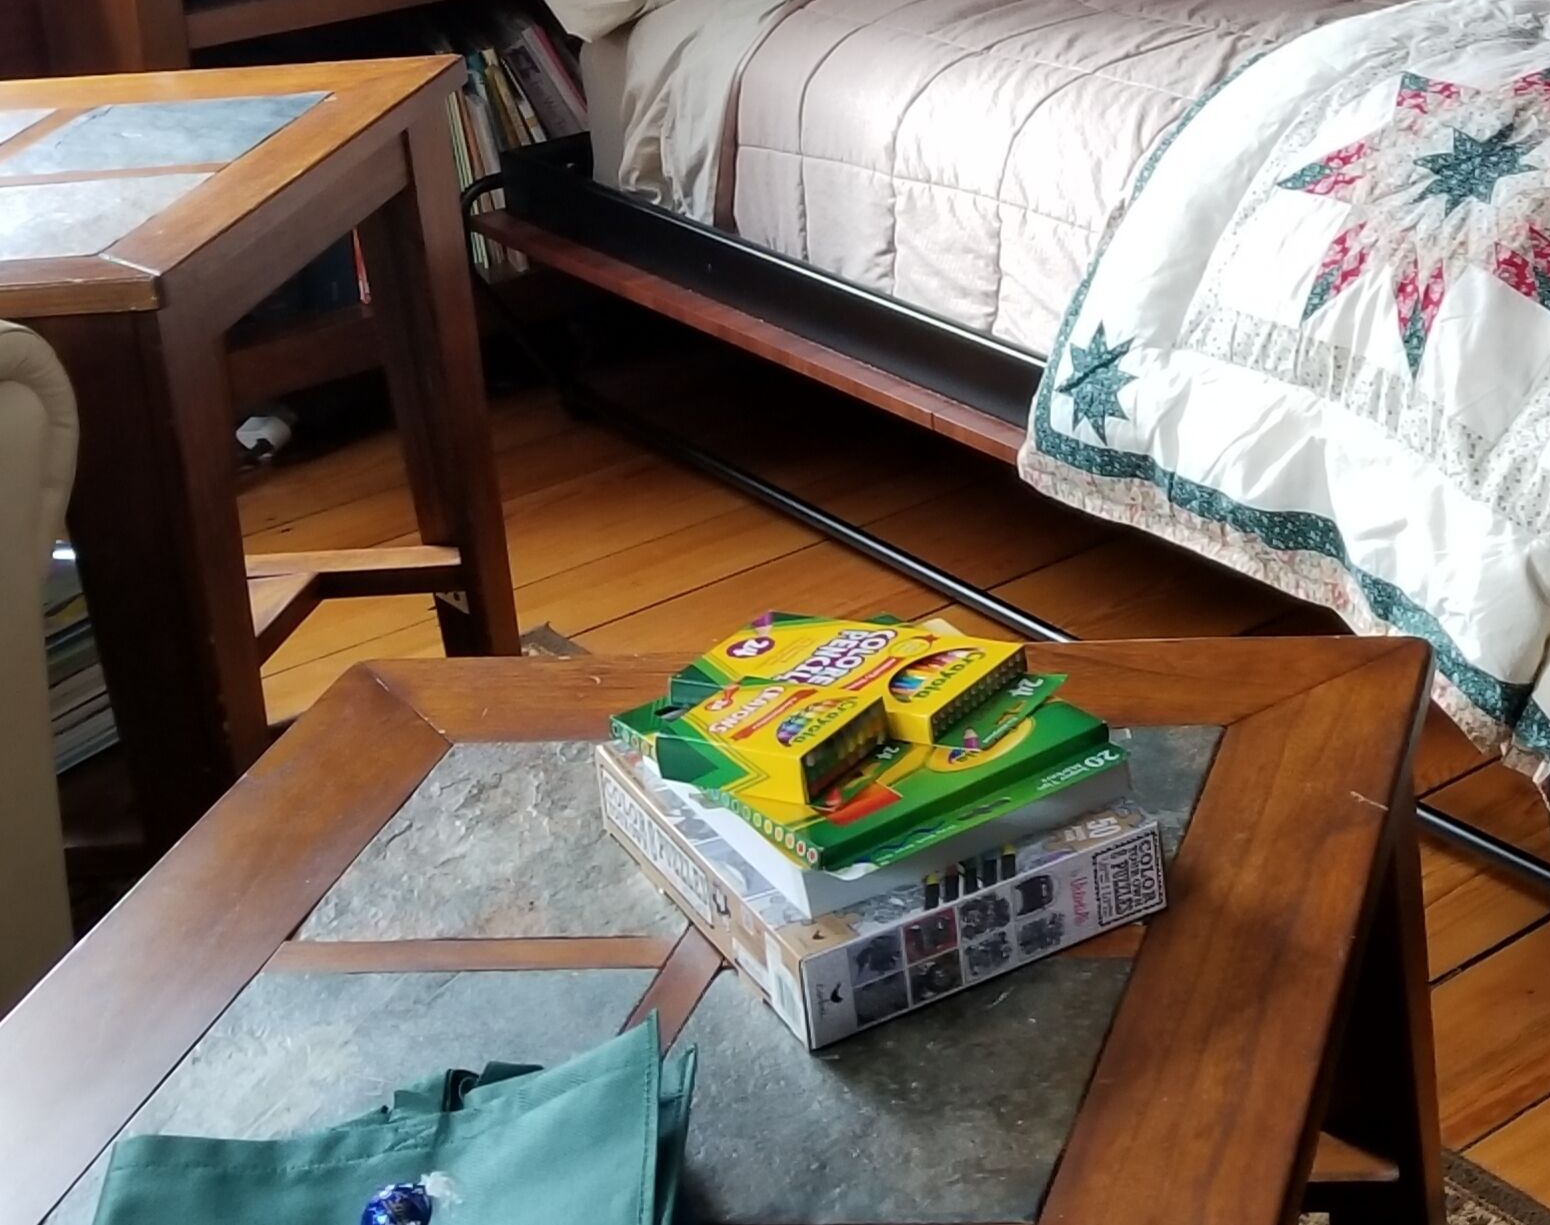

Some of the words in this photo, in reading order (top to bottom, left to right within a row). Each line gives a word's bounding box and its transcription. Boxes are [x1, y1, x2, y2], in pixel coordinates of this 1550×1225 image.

[732, 639, 770, 657] 24
[776, 630, 869, 685] PENCIL
[807, 630, 897, 685] COLORE
[913, 649, 987, 700] Crayola
[1008, 678, 1044, 696] 24
[708, 686, 785, 733] CRAYONS
[793, 700, 858, 745] Crayola
[875, 746, 900, 759] 24
[1083, 749, 1121, 769] 20
[1086, 817, 1121, 839] 50
[1110, 859, 1134, 915] PUZZLES
[1139, 839, 1156, 903] COLOR
